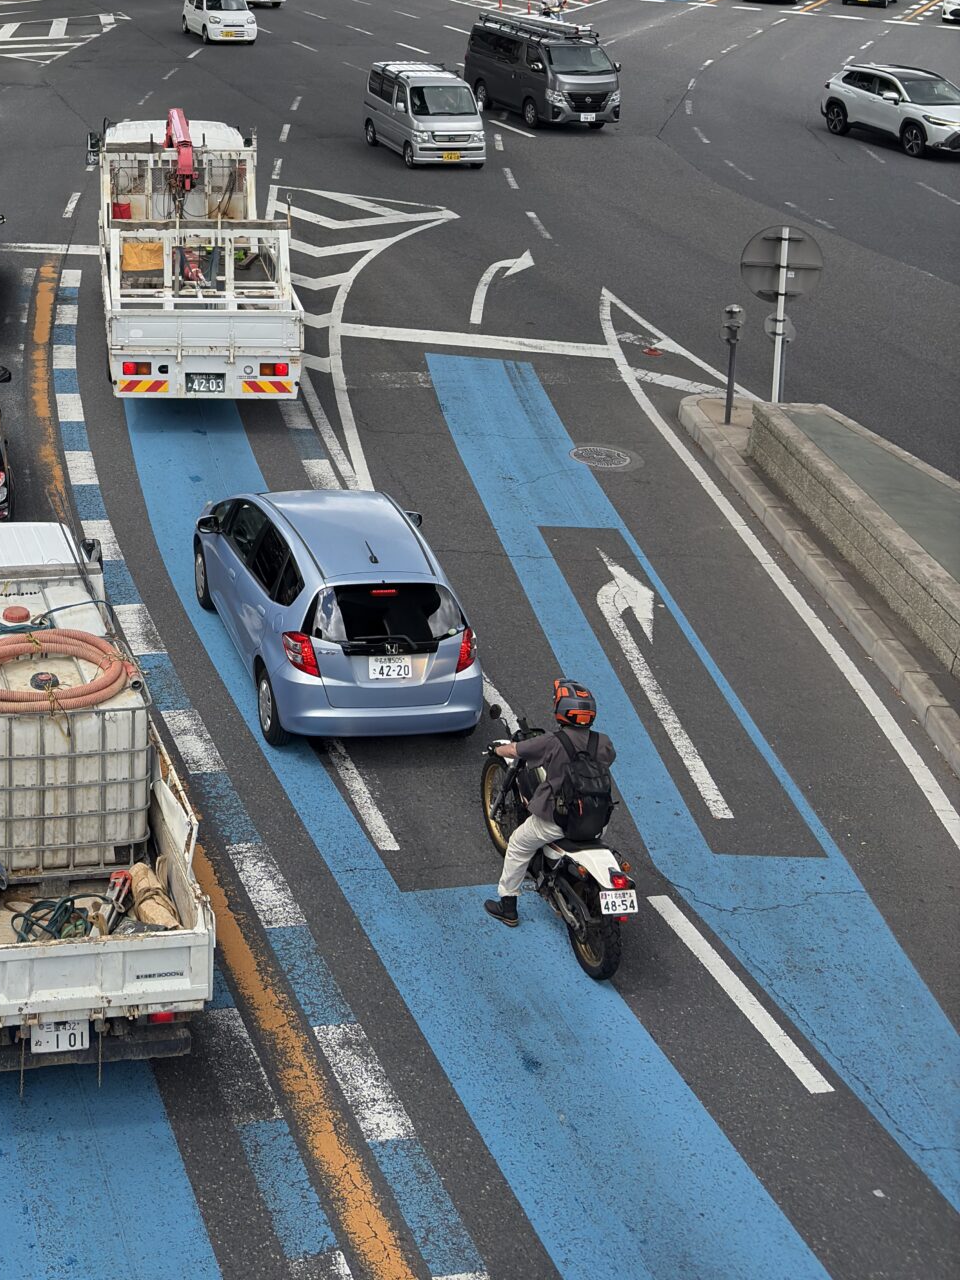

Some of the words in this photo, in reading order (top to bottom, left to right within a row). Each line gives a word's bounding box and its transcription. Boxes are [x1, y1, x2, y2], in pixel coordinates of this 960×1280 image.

[192, 379, 223, 391] 42-03
[378, 664, 410, 677] 42-20
[603, 899, 635, 912] 48-54
